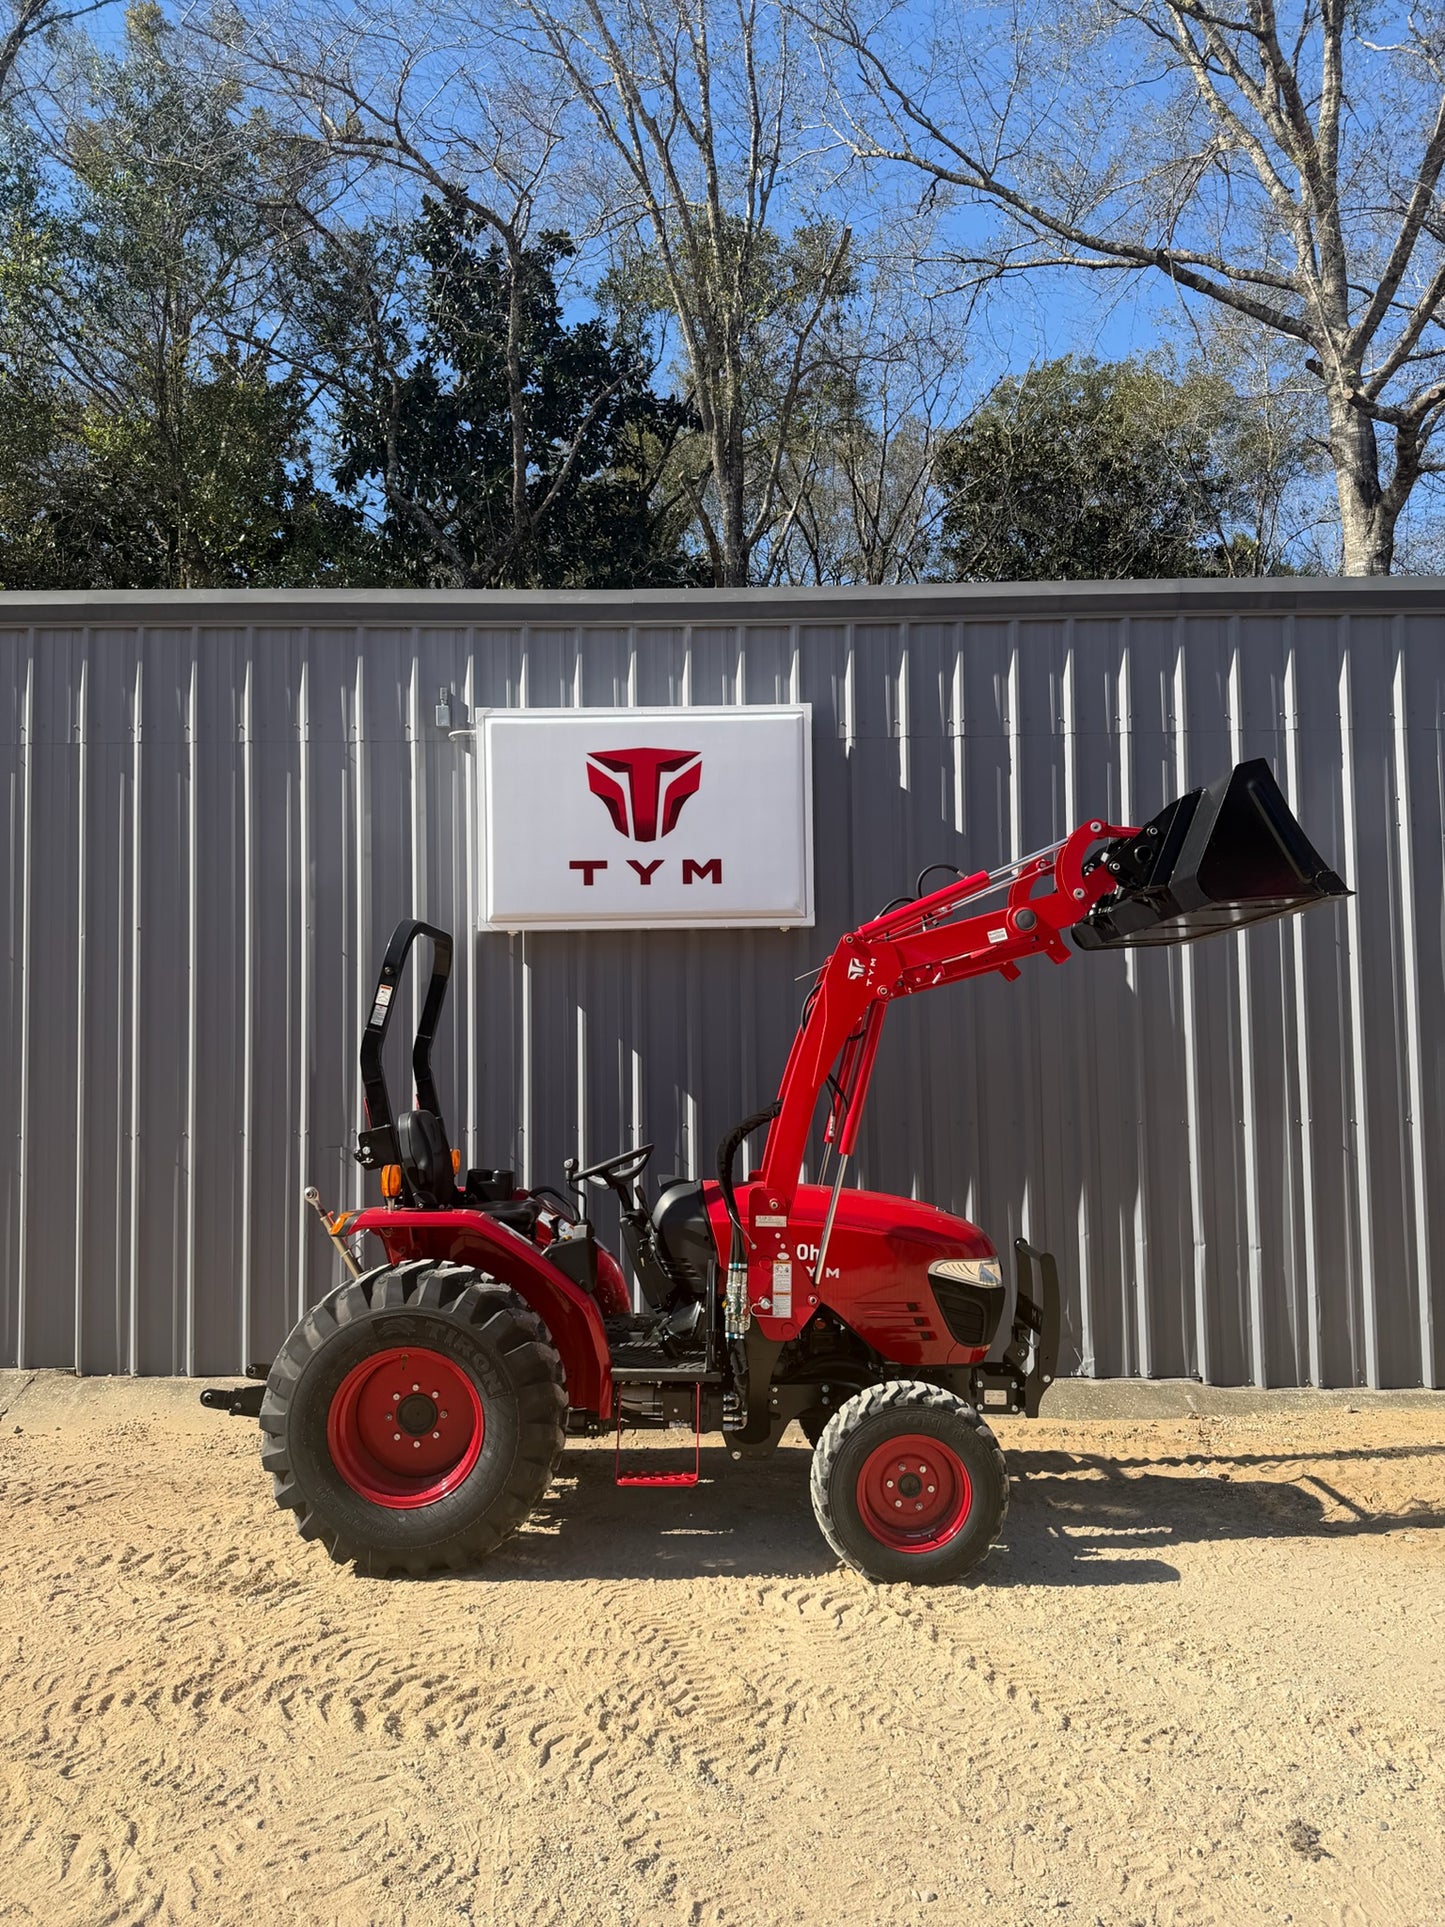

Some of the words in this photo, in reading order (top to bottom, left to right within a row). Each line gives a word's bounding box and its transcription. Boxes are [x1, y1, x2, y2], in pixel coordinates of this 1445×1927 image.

[569, 858, 722, 886] TYM
[866, 957, 877, 987] TYM
[805, 1265, 840, 1279] YM
